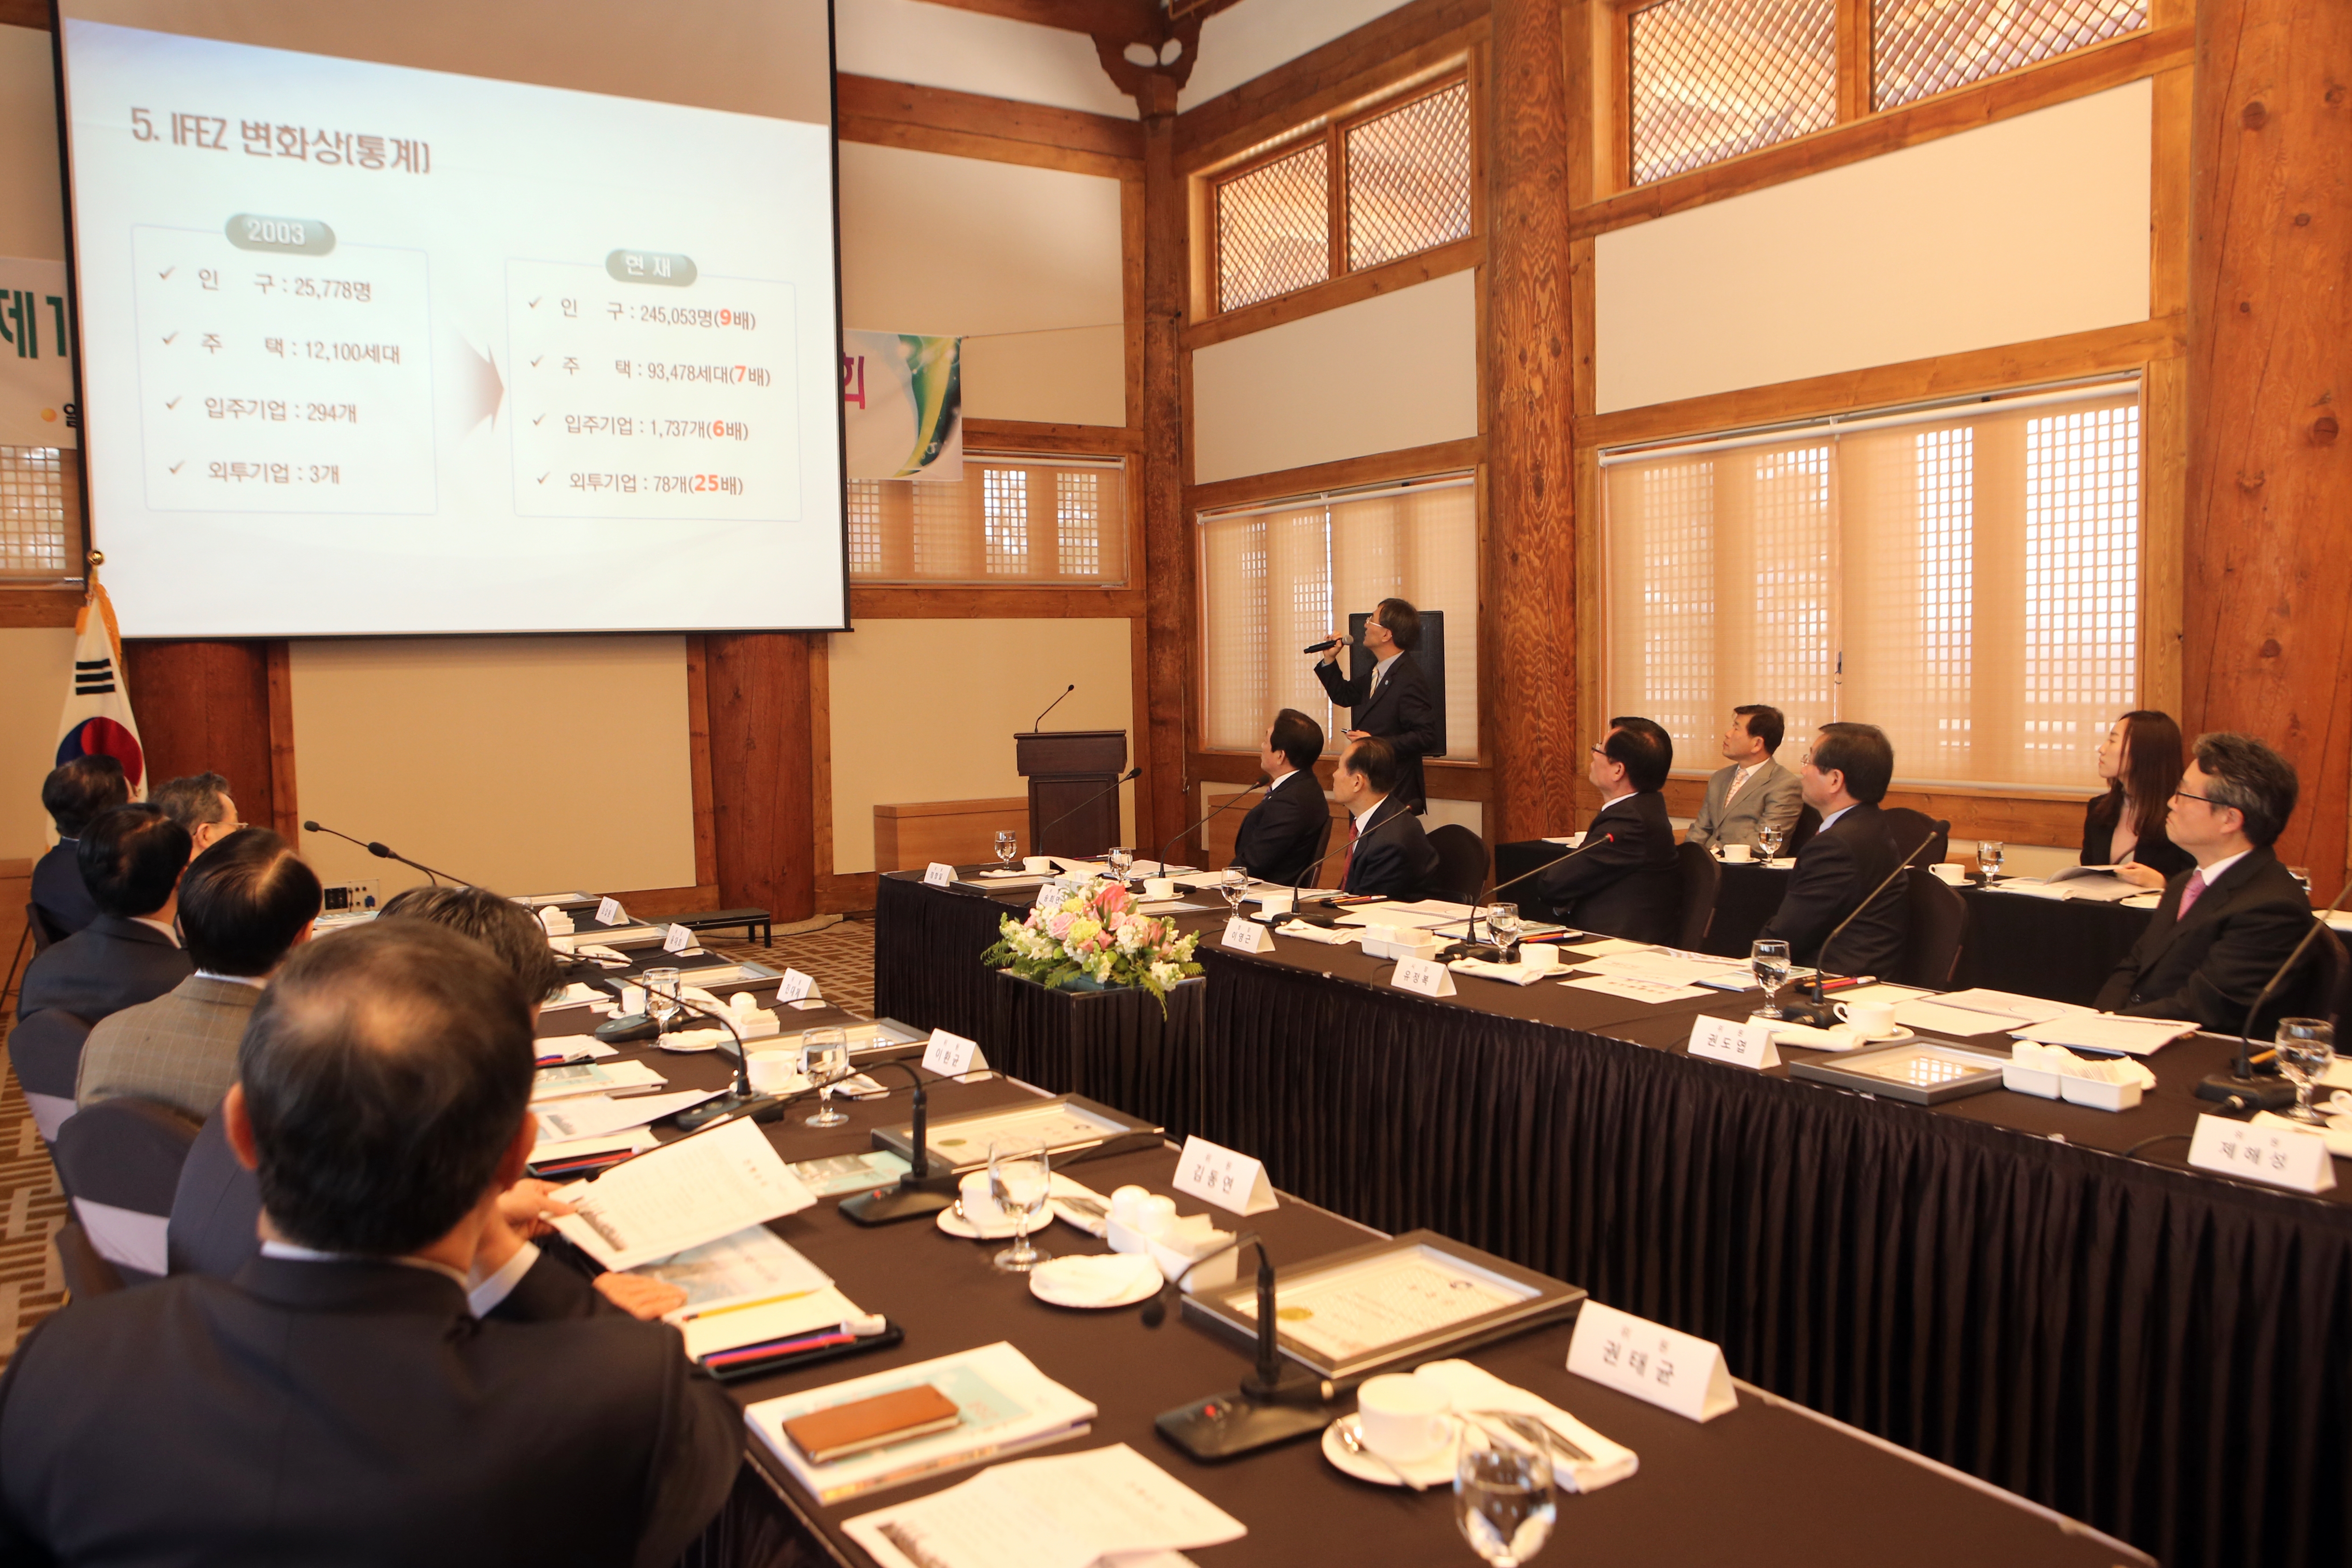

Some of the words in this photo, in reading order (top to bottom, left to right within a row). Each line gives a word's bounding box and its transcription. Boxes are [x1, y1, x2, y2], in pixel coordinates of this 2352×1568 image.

[131, 107, 160, 142] 5.
[171, 113, 228, 151] IFEZ
[247, 220, 306, 246] 2003
[294, 277, 372, 303] 25,778명
[640, 305, 756, 331] 245,053명(9배)
[305, 341, 400, 365] 12,100세대
[647, 363, 771, 387] 93,478세대(7배)
[204, 397, 287, 421] 입주기업
[306, 403, 357, 424] 294개
[564, 414, 633, 436] 입주기업
[651, 420, 749, 441] 1,737개(6배)
[208, 462, 290, 484] 외투기업
[309, 465, 340, 485] 3개
[569, 473, 637, 493] 외투기업
[654, 474, 743, 495] 78개(25배)
[1231, 931, 1252, 944] 이영근
[1404, 970, 1429, 986] 유정복
